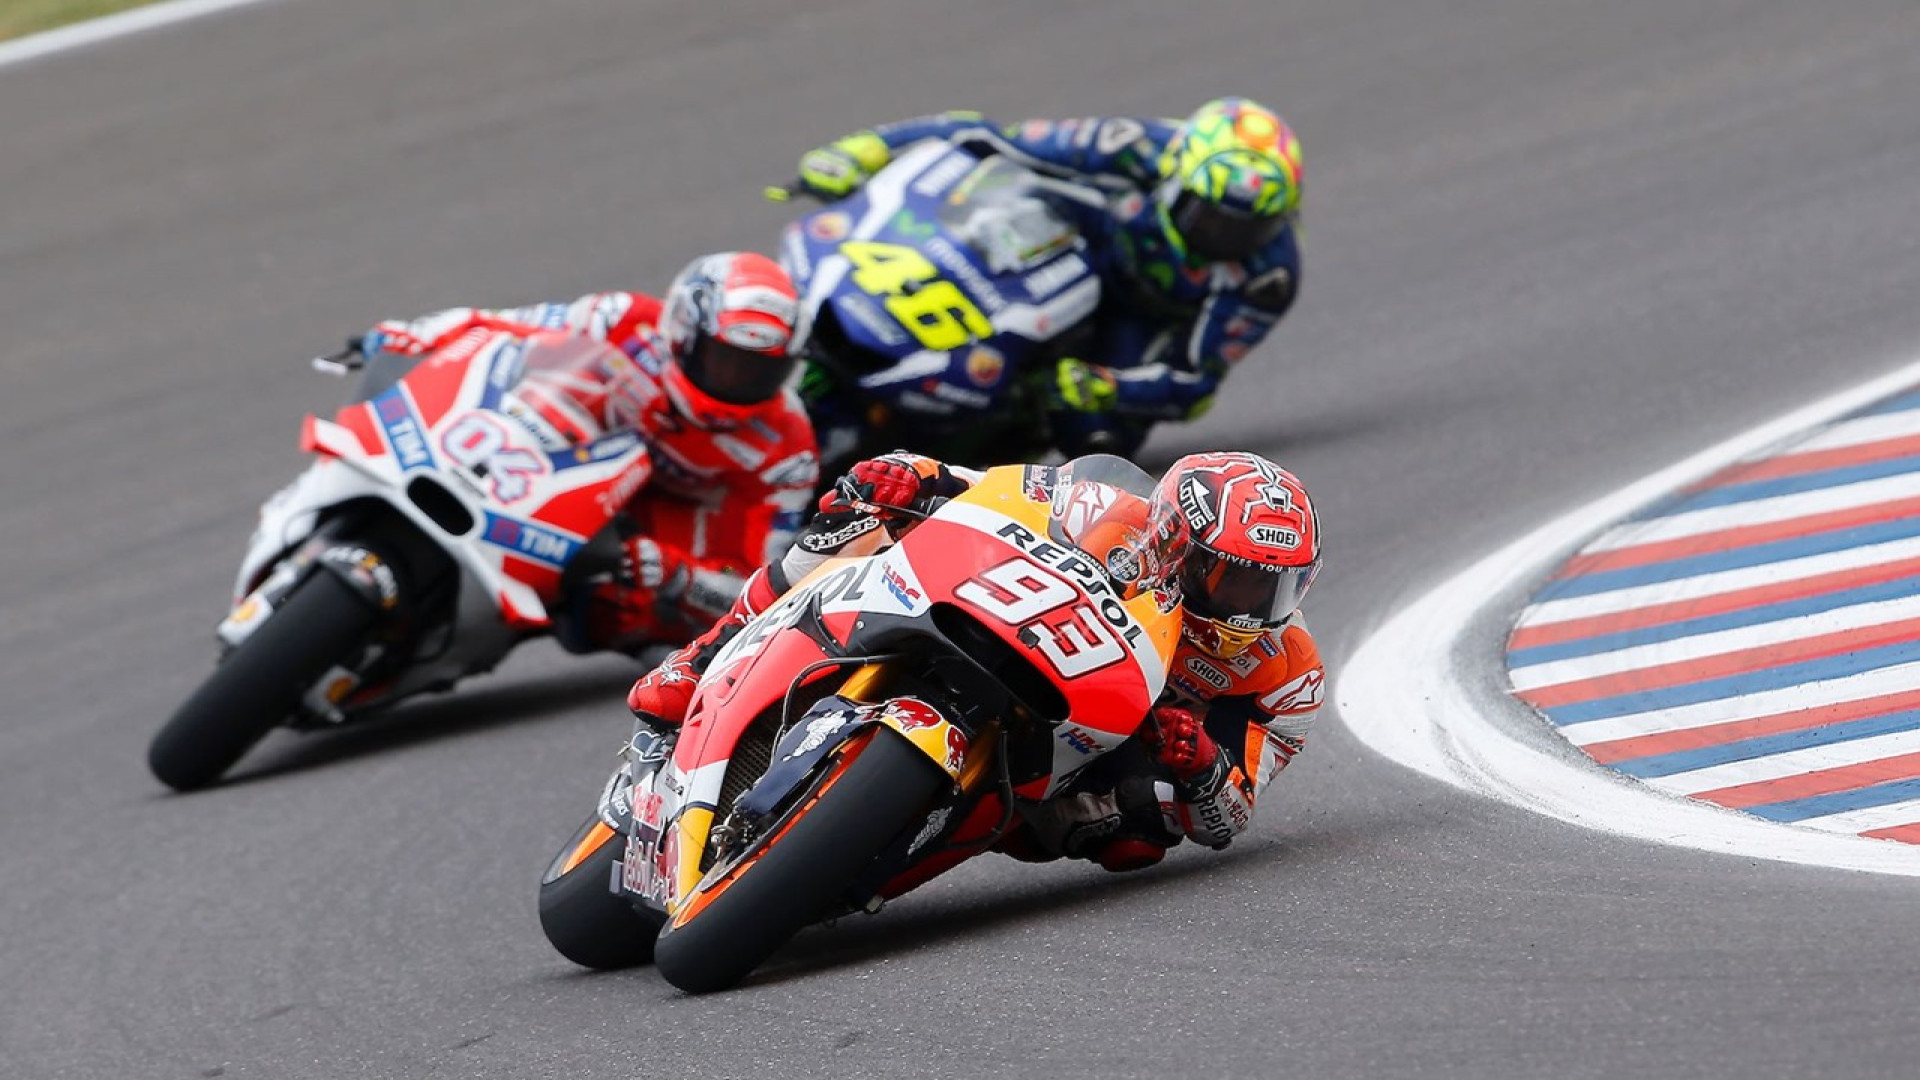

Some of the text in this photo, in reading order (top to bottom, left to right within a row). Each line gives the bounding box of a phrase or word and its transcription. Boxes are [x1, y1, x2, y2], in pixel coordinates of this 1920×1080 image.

[839, 241, 994, 351] 46
[388, 418, 428, 465] TIM
[441, 410, 547, 505] 04
[1179, 478, 1207, 530] LOTUS
[520, 527, 569, 560] TIM
[1256, 528, 1296, 547] SHOEI
[1072, 547, 1111, 581] HONDA
[1217, 551, 1252, 567] GIVES
[1259, 563, 1283, 574] YOU
[995, 522, 1144, 650] REPSOL
[952, 558, 1127, 679] 93
[1227, 616, 1262, 629] LOTUS
[1190, 660, 1226, 687] SHOEI
